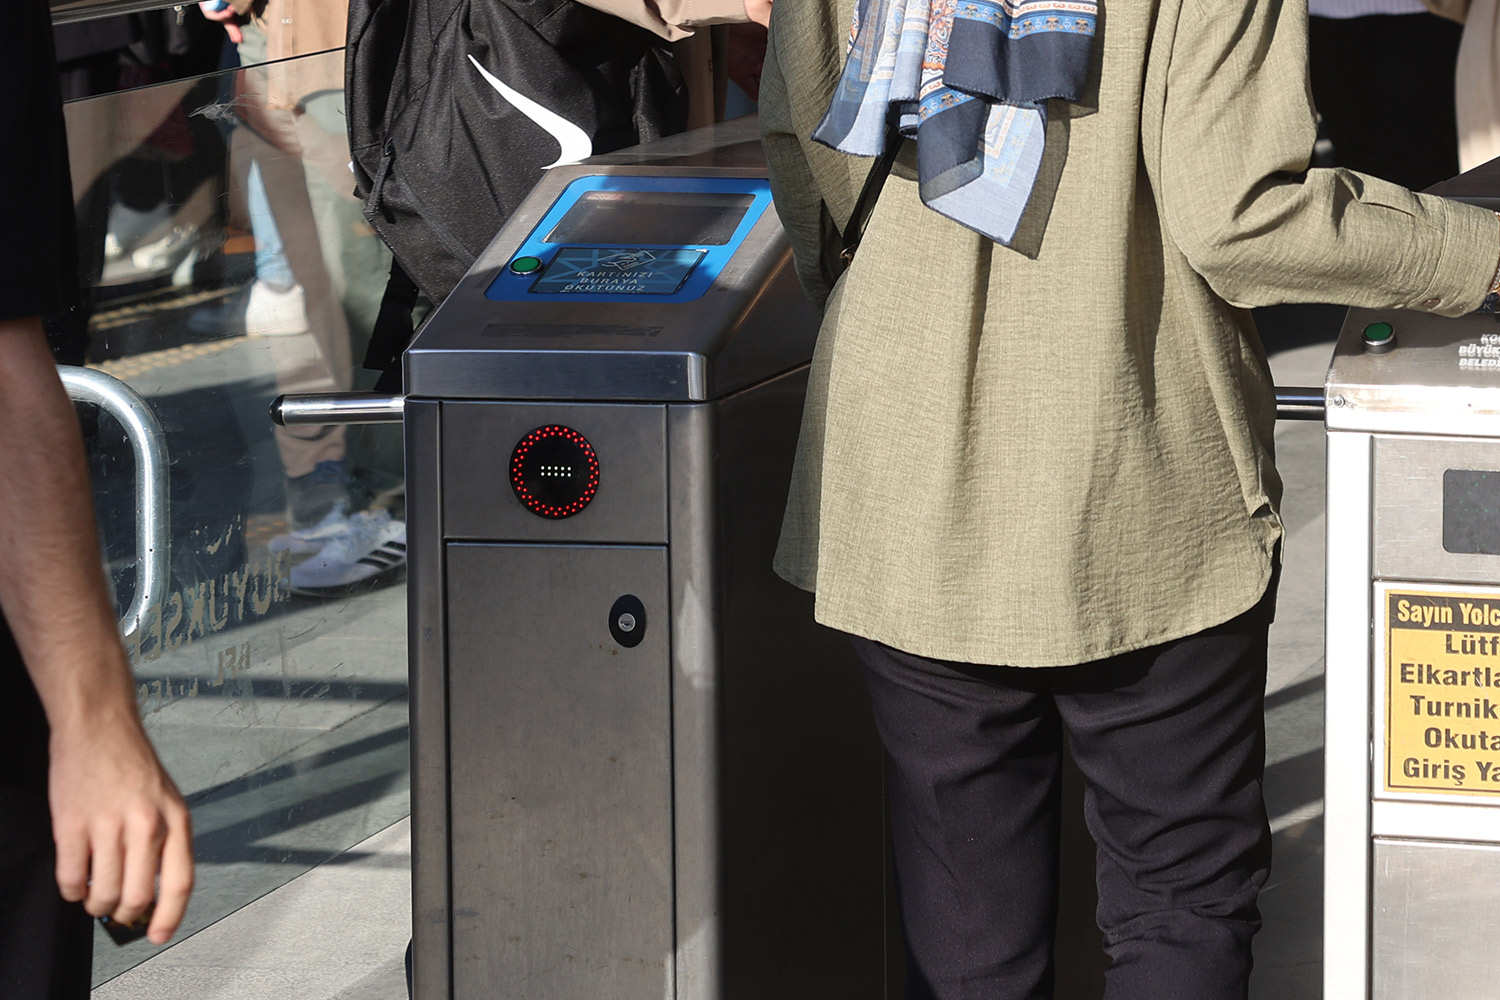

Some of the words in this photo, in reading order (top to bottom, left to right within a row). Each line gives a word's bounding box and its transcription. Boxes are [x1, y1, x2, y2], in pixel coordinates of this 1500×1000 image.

[577, 270, 653, 278] KARTINIZI
[1396, 599, 1453, 627] Sayın
[1403, 757, 1466, 787] Giriş
